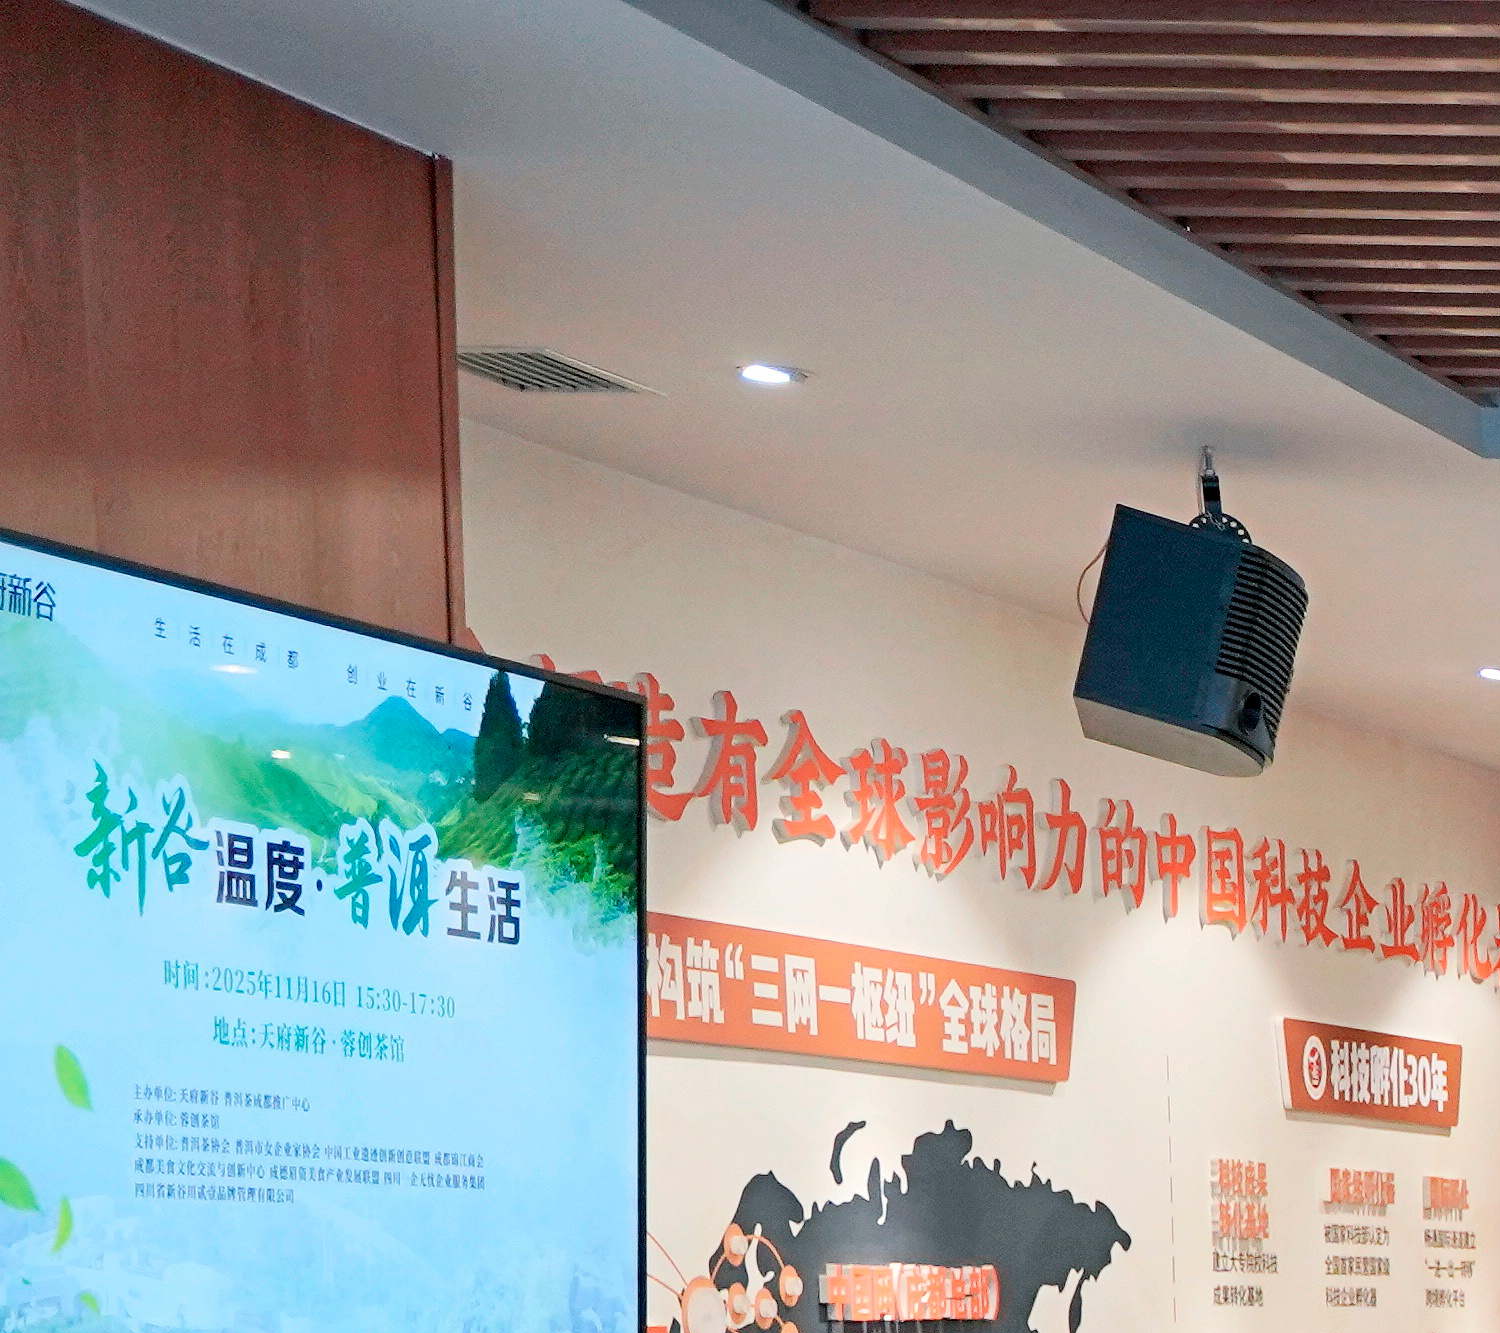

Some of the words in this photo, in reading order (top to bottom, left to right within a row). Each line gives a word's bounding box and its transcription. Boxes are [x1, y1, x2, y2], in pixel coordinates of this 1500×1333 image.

[1330, 1039, 1450, 1113] 科技孵化30年
